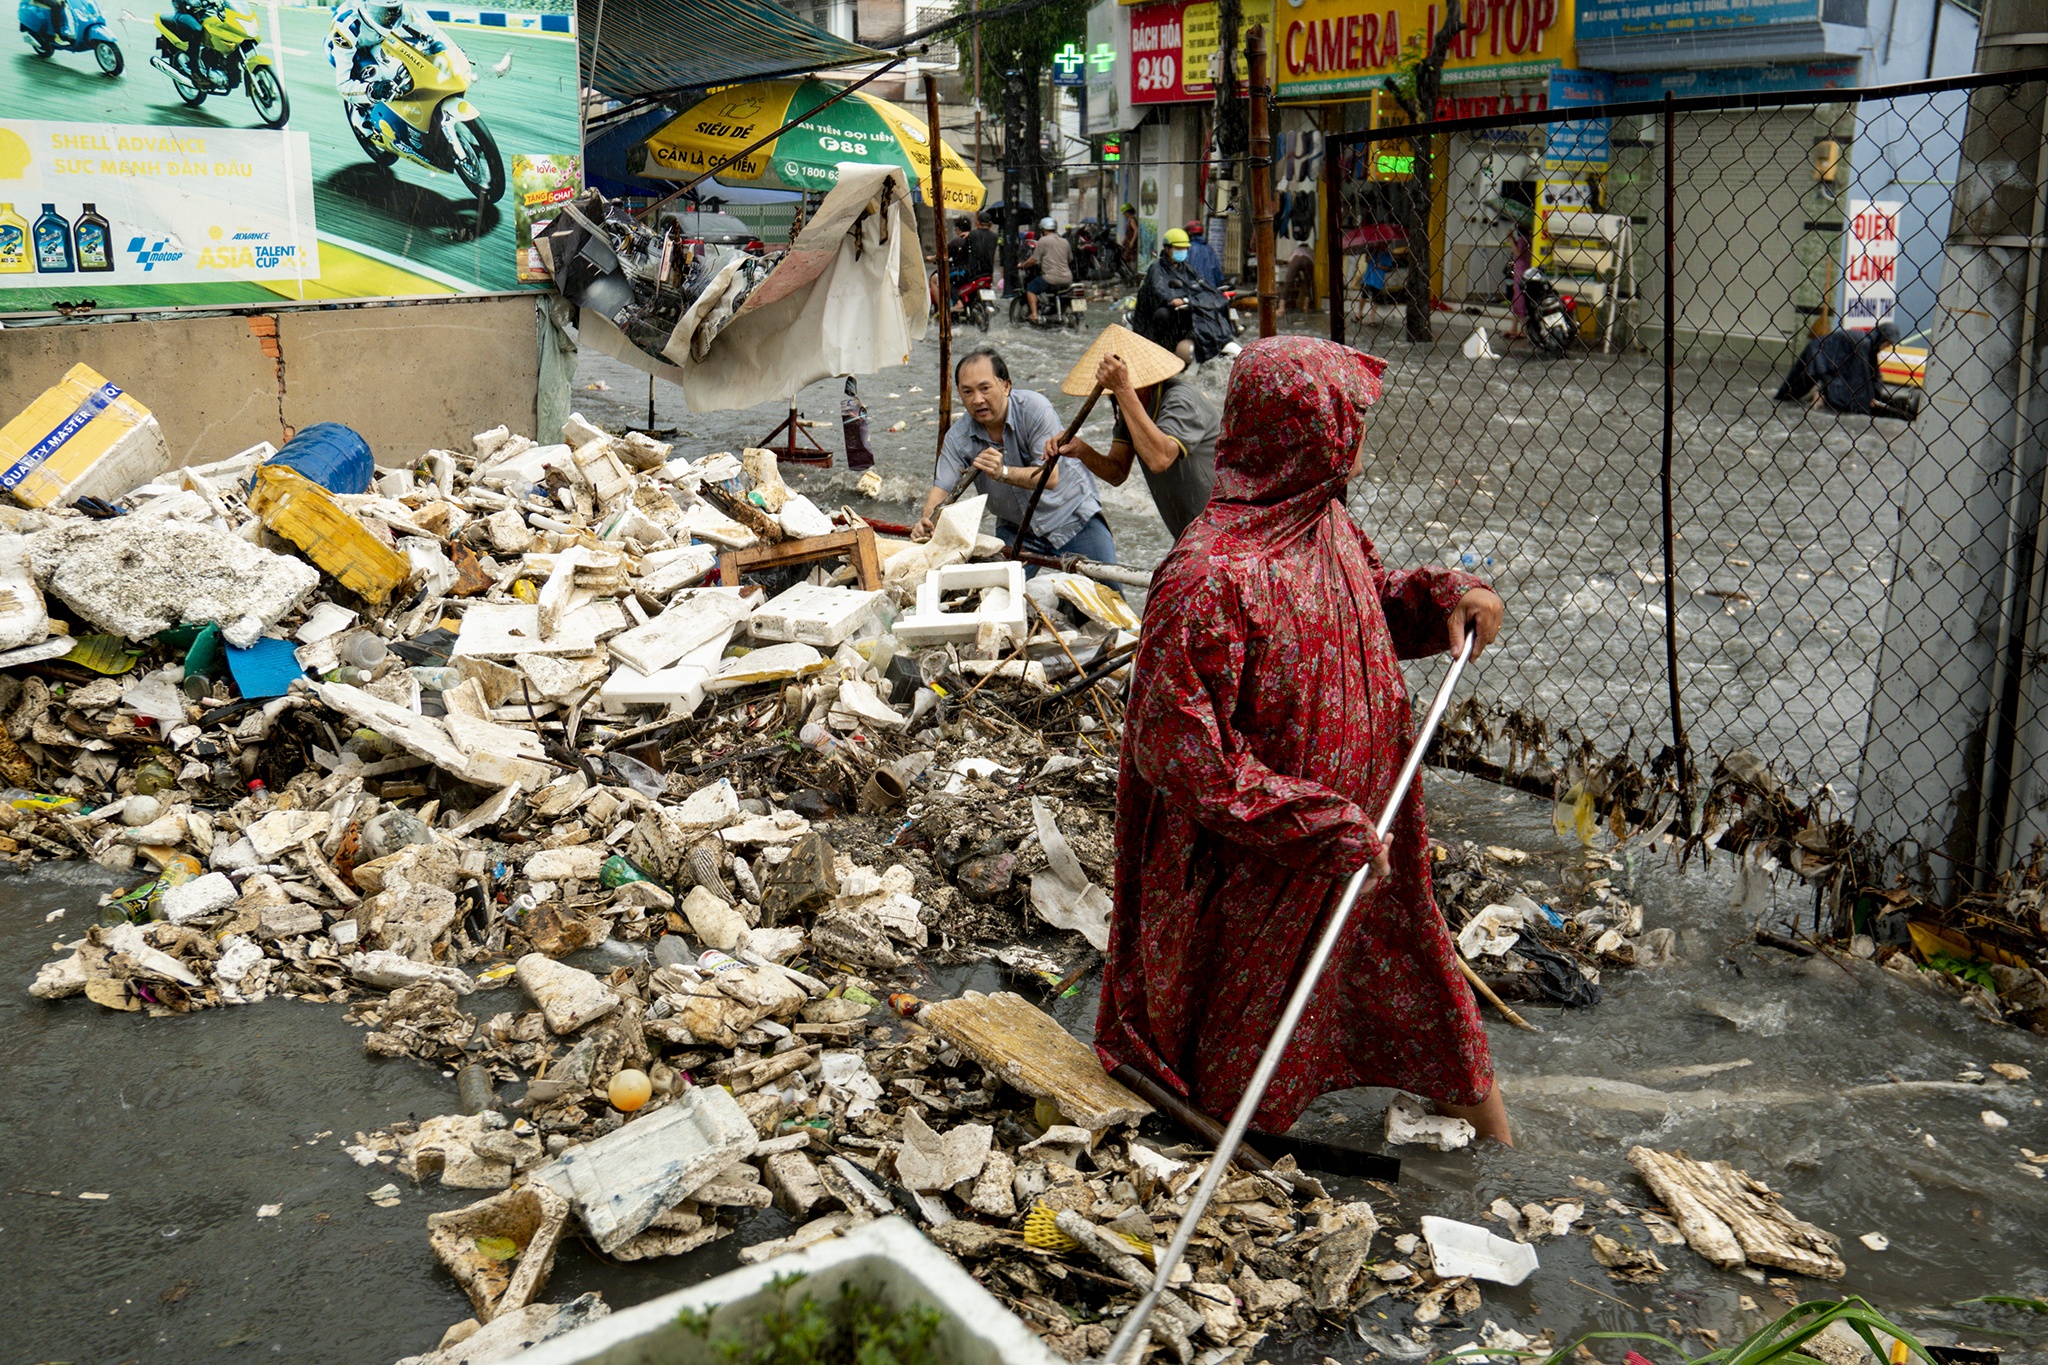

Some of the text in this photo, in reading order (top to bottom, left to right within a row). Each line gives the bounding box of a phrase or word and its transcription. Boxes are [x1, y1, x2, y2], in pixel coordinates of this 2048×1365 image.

[1133, 18, 1181, 52] BÁCH HÓA
[1286, 10, 1401, 75] CAMERA
[1427, 0, 1559, 57] LAPTOP
[400, 48, 425, 69] STANLEY
[1138, 55, 1176, 91] 249
[694, 121, 756, 139] SIÊU DỄ
[816, 125, 841, 136] TIỀN
[843, 130, 867, 141] GỌI
[870, 131, 894, 143] LIỀN
[51, 133, 207, 153] SHELL ADVANCE
[819, 136, 868, 155] F88
[657, 144, 688, 163] CẦN
[690, 150, 704, 166] LÀ
[708, 154, 729, 167] CÓ
[801, 166, 826, 179] 1800
[231, 231, 270, 241] ADVANCE
[1854, 207, 1895, 247] ĐIỆN
[197, 245, 296, 269] ASIA TALENT
[255, 257, 279, 268] CUP
[1850, 255, 1894, 288] LẠNH
[47, 410, 92, 447] MASTER
